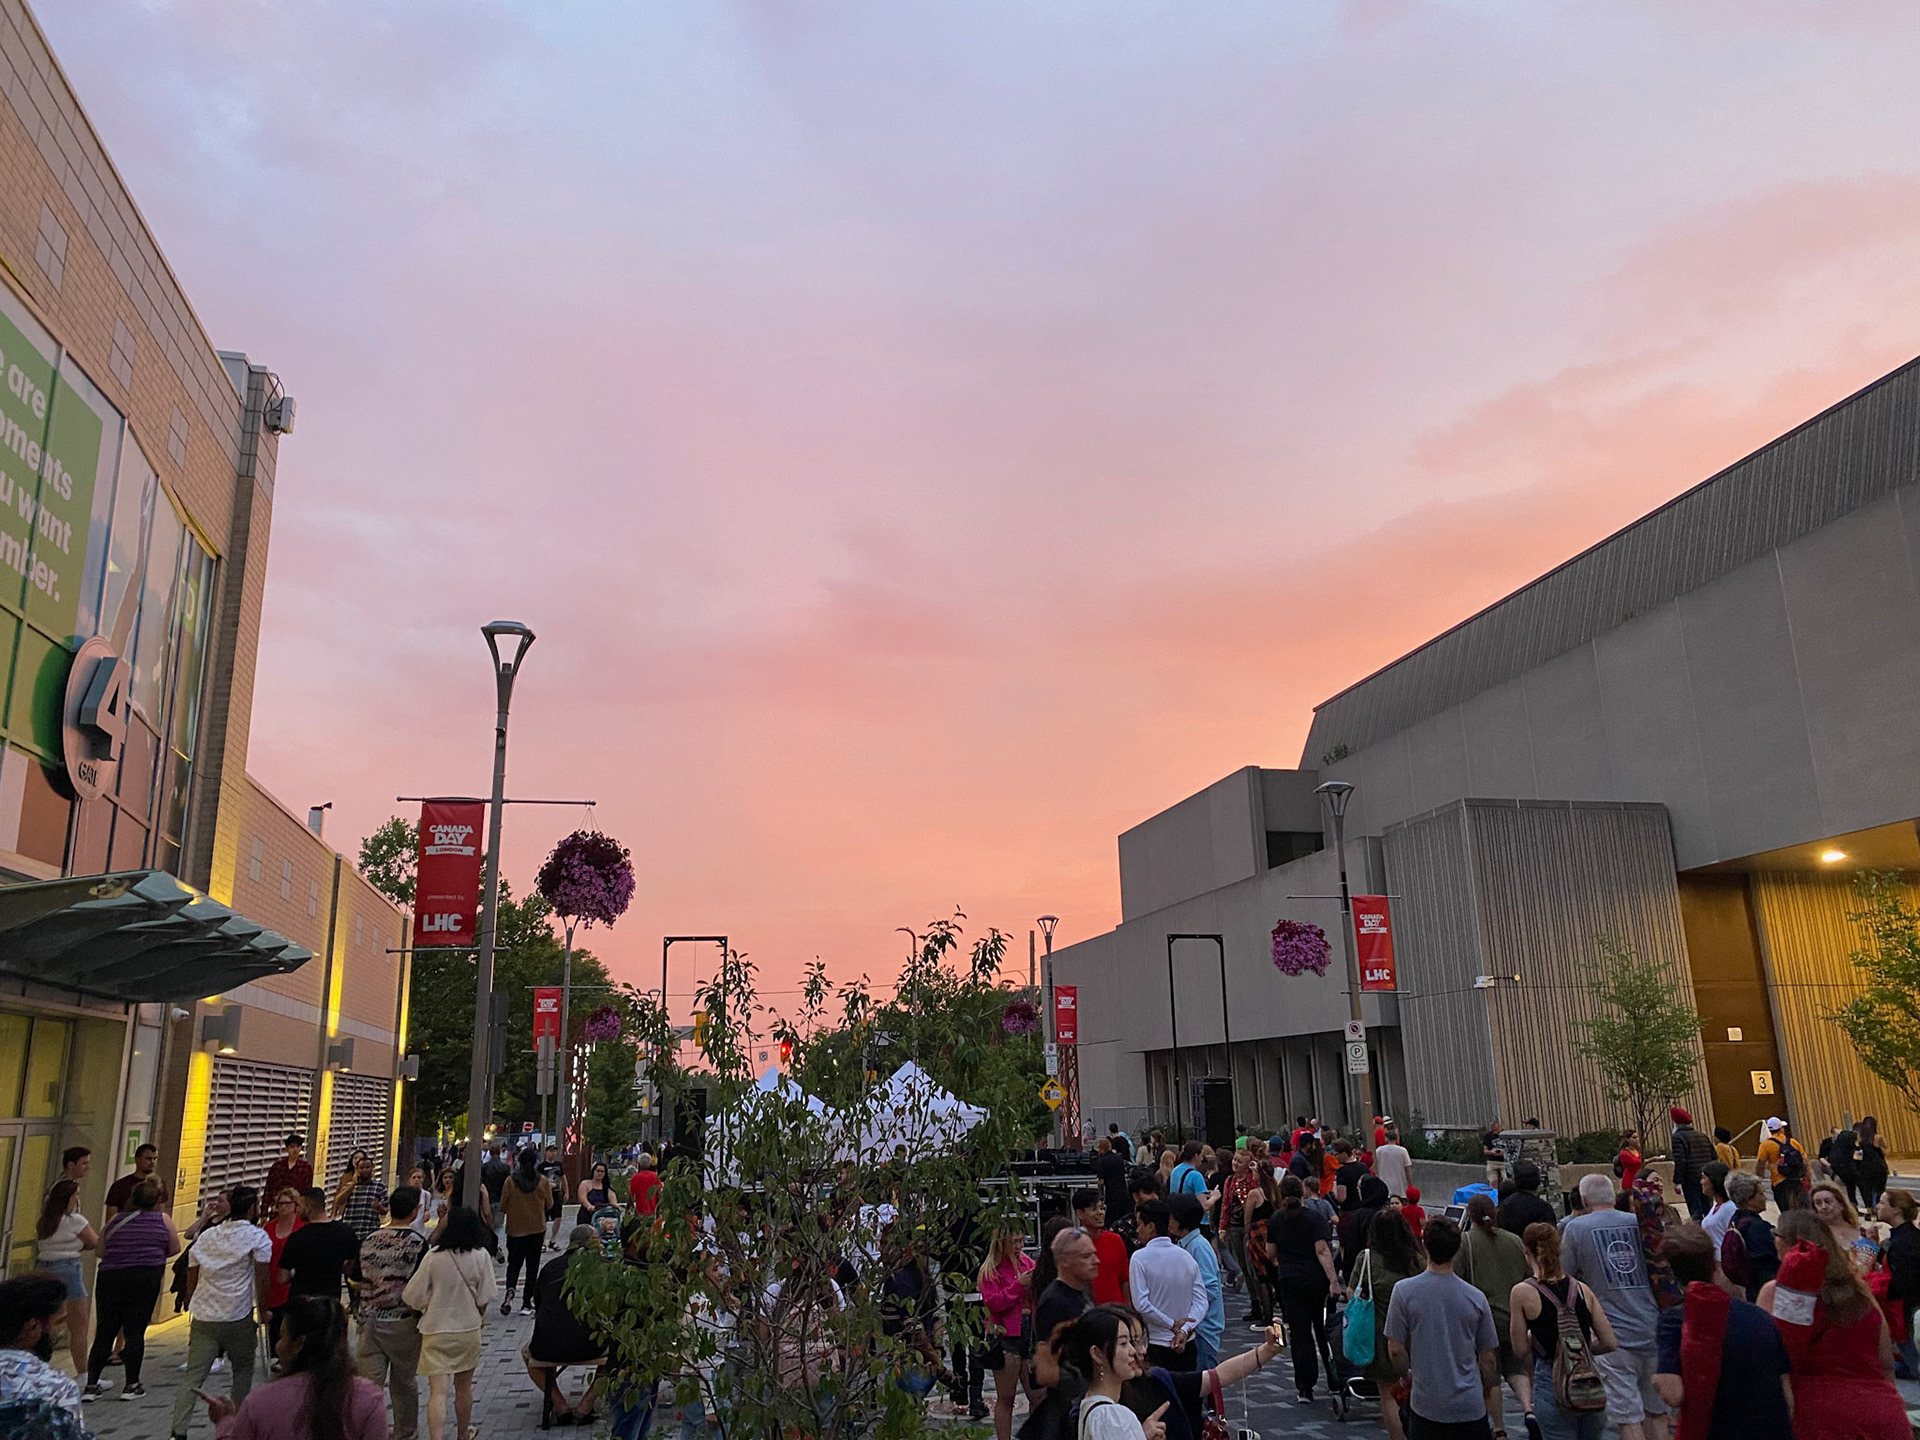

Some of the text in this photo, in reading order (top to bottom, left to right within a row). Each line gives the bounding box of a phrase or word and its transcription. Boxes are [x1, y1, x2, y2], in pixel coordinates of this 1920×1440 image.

[8, 364, 46, 419] are
[19, 486, 71, 555] want
[95, 657, 131, 761] 4
[429, 825, 473, 833] CANADA
[434, 833, 467, 844] DAY
[423, 913, 462, 931] LHC
[1365, 969, 1390, 981] LHC
[1759, 1076, 1767, 1090] 3
